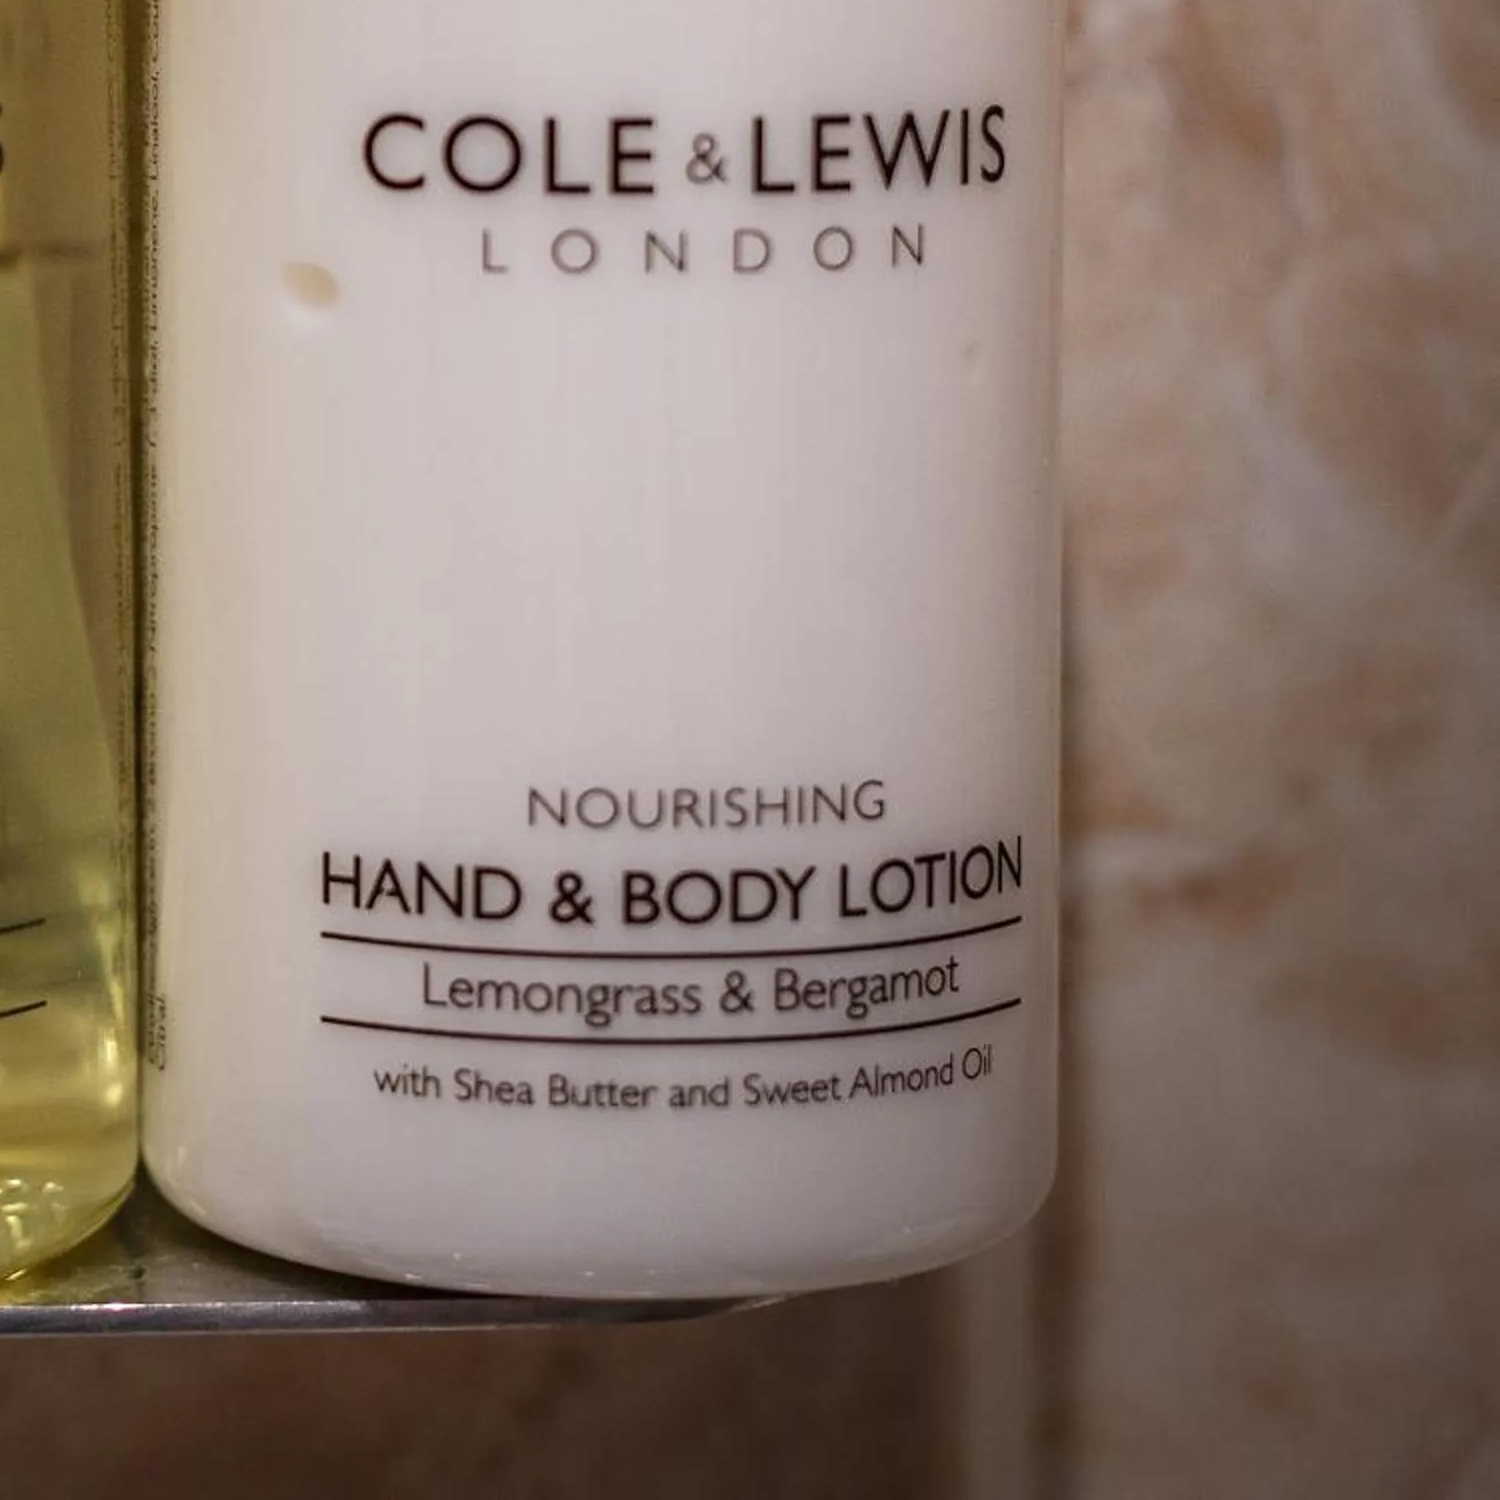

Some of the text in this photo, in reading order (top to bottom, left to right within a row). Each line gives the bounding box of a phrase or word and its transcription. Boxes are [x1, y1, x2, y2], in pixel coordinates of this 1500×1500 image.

[363, 103, 1006, 195] COLE & LEWIS
[481, 223, 925, 274] LONDON
[527, 779, 887, 829] NOURISHING
[321, 835, 1024, 927] HAND & BODY LOTION
[422, 955, 960, 1029] Lemongrass & Bergamot
[373, 1042, 994, 1108] with Shea Butter and Sweet Almond Oil
